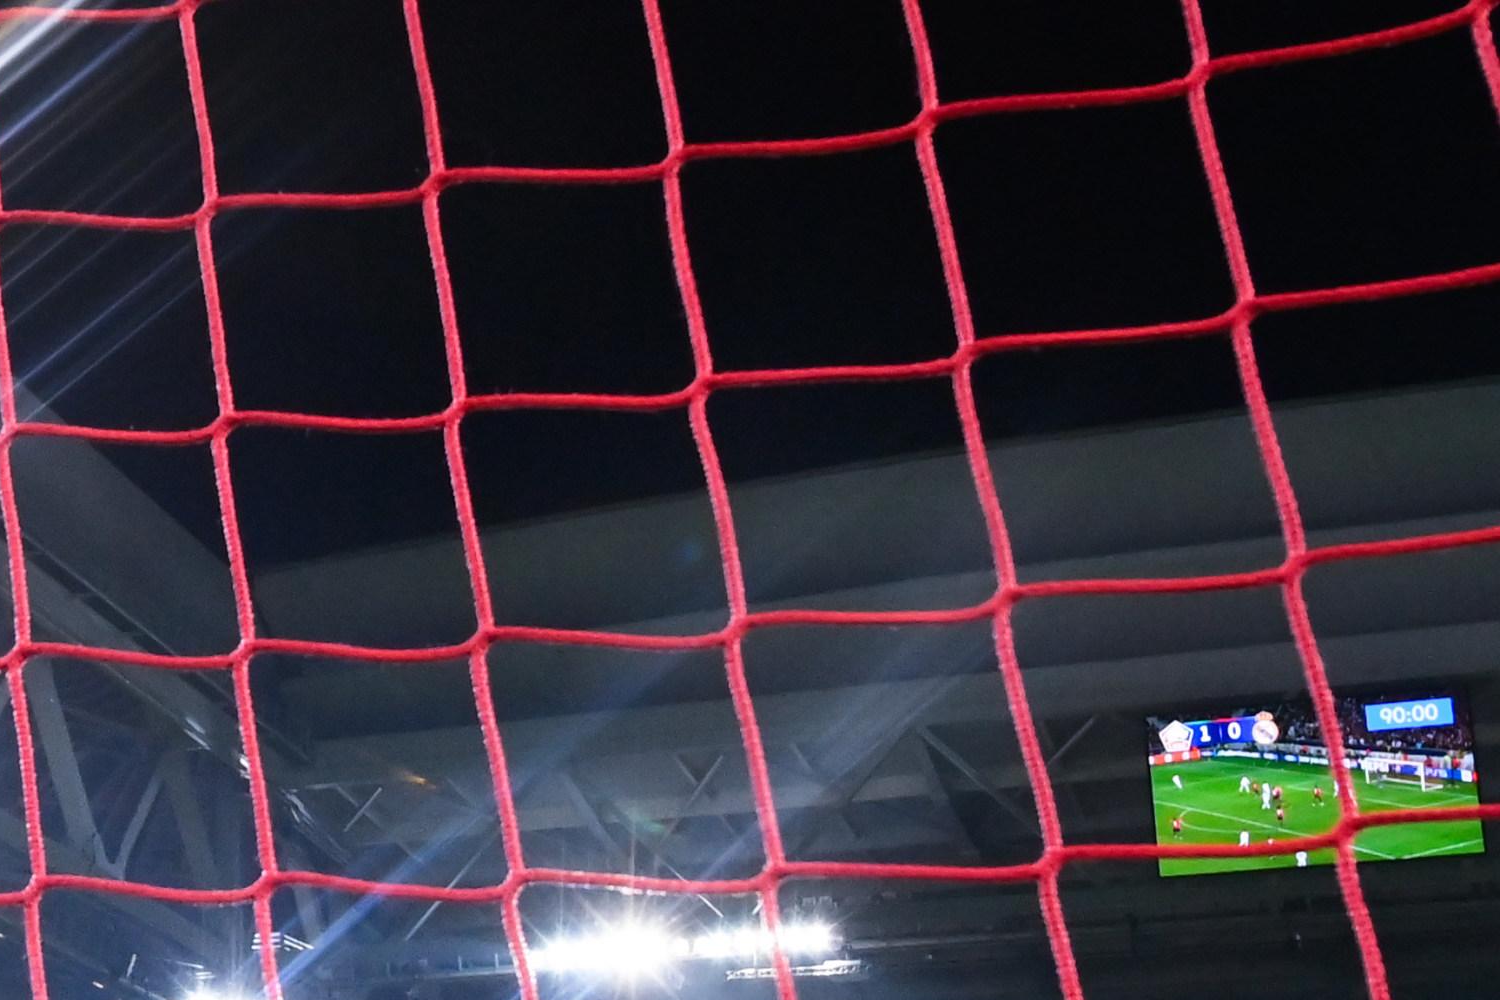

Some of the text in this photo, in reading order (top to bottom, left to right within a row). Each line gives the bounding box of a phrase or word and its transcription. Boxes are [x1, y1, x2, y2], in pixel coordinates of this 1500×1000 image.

[1380, 704, 1439, 724] 90:00
[1200, 722, 1241, 742] 1 0
